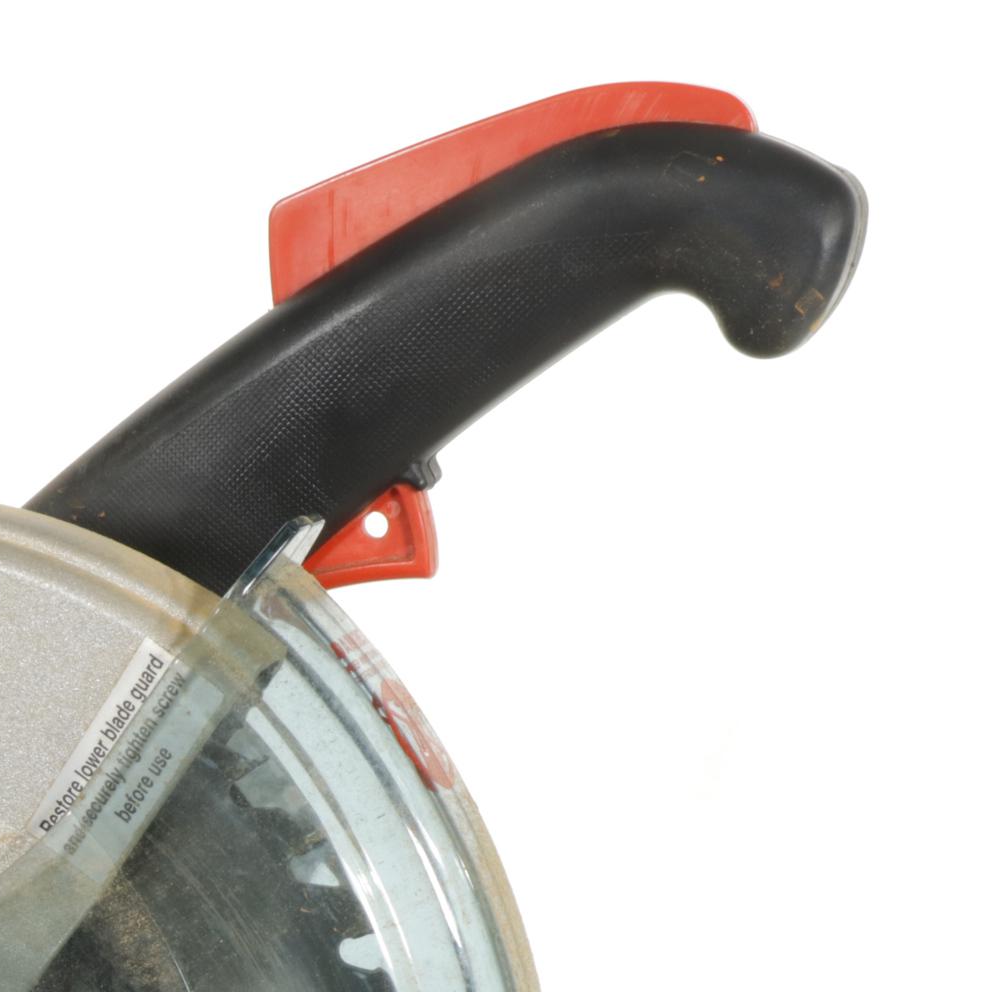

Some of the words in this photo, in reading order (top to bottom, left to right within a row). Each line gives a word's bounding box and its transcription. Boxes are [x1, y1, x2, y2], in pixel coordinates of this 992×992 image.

[39, 778, 84, 832] Restore
[77, 739, 109, 783] lower
[101, 699, 136, 741] blade
[132, 653, 164, 703] guard
[82, 766, 126, 826] securely
[118, 716, 159, 766] tighten
[153, 672, 186, 717] screw
[114, 778, 154, 824] before
[148, 746, 172, 775] use
